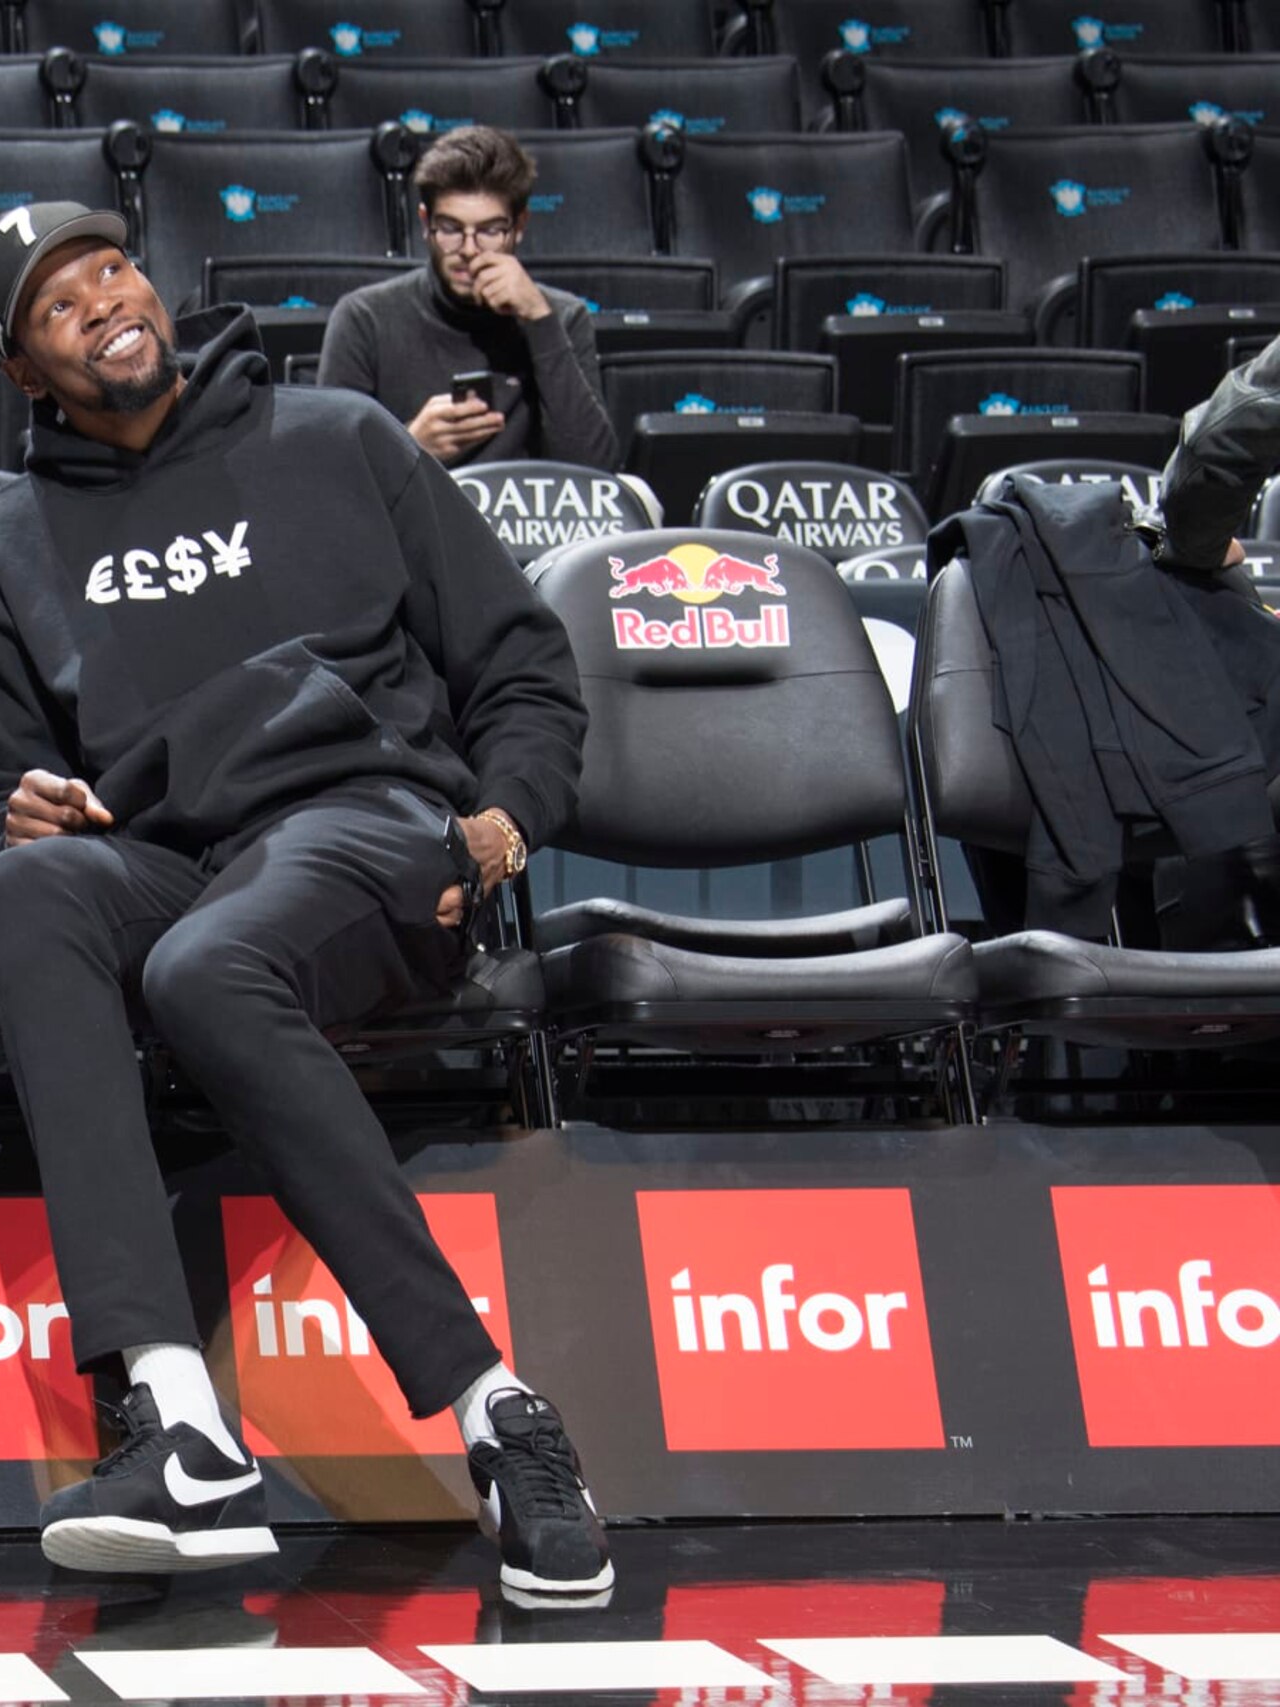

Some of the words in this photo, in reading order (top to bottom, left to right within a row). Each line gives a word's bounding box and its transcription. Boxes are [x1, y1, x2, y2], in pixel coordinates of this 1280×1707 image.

[727, 480, 901, 528] QATAR
[776, 521, 904, 547] AIRWAYS
[611, 607, 702, 649] Red
[701, 604, 790, 649] Bull
[670, 1263, 907, 1352] infor
[1087, 1259, 1280, 1348] info
[950, 1435, 974, 1449] TM
